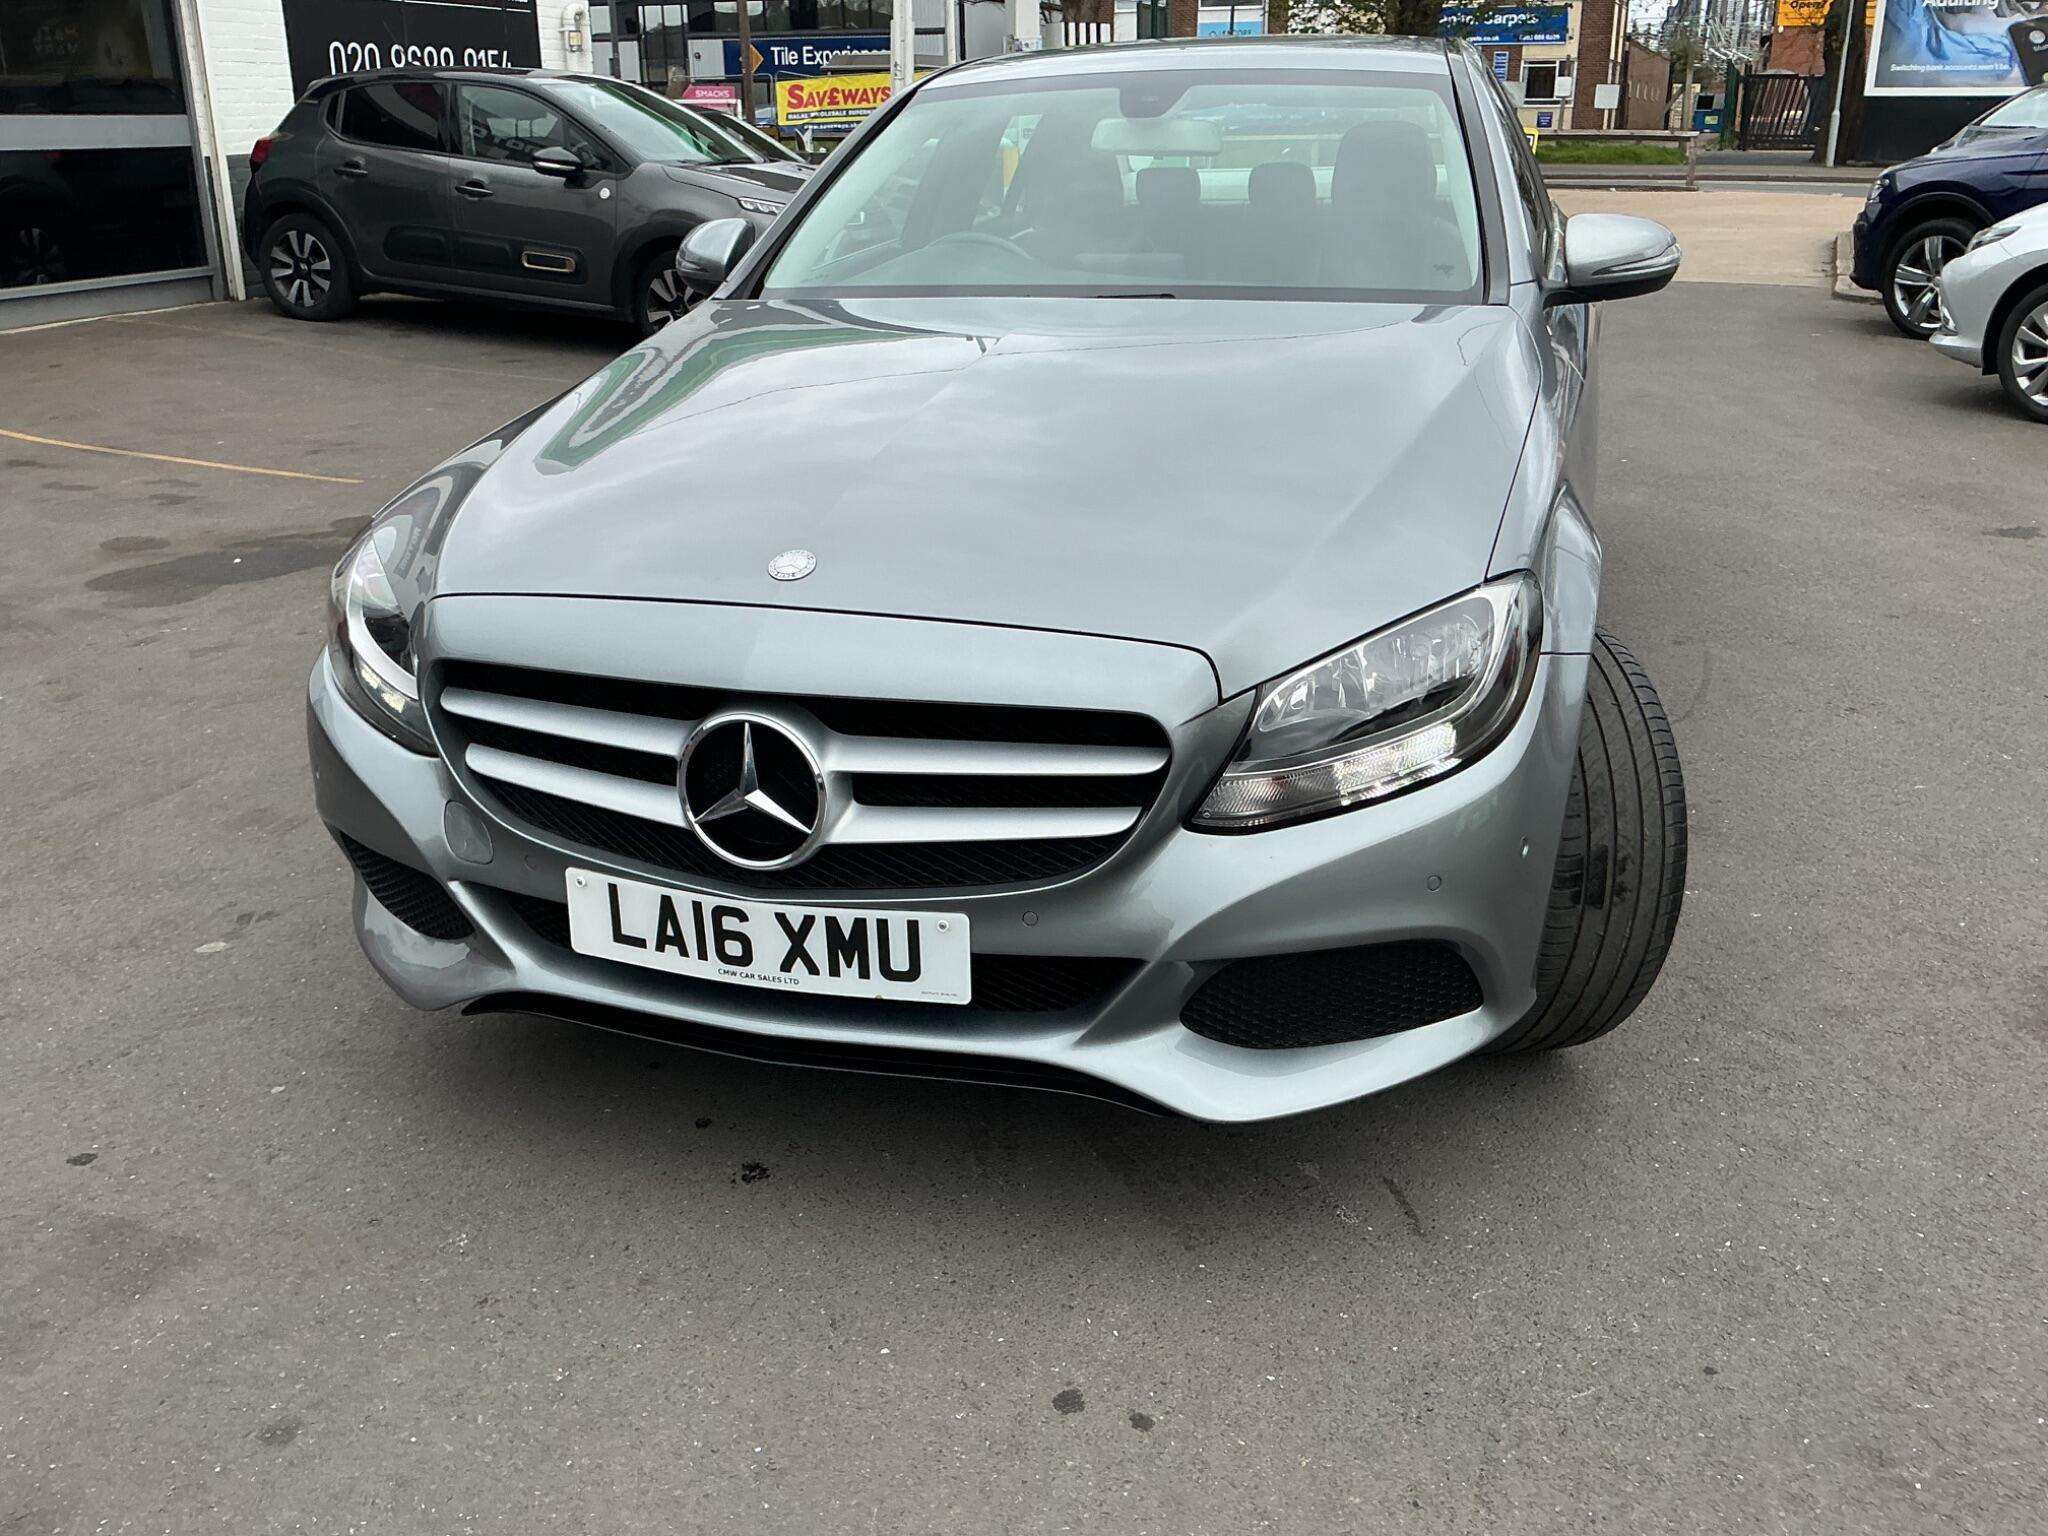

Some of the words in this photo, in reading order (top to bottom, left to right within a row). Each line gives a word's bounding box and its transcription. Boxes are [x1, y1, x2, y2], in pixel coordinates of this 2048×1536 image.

[329, 41, 381, 76] 020
[770, 46, 798, 66] Tile
[607, 882, 754, 968] LA16
[774, 912, 922, 983] XMU
[718, 968, 738, 977] CMW
[740, 972, 756, 980] CAR
[757, 974, 782, 984] SALES
